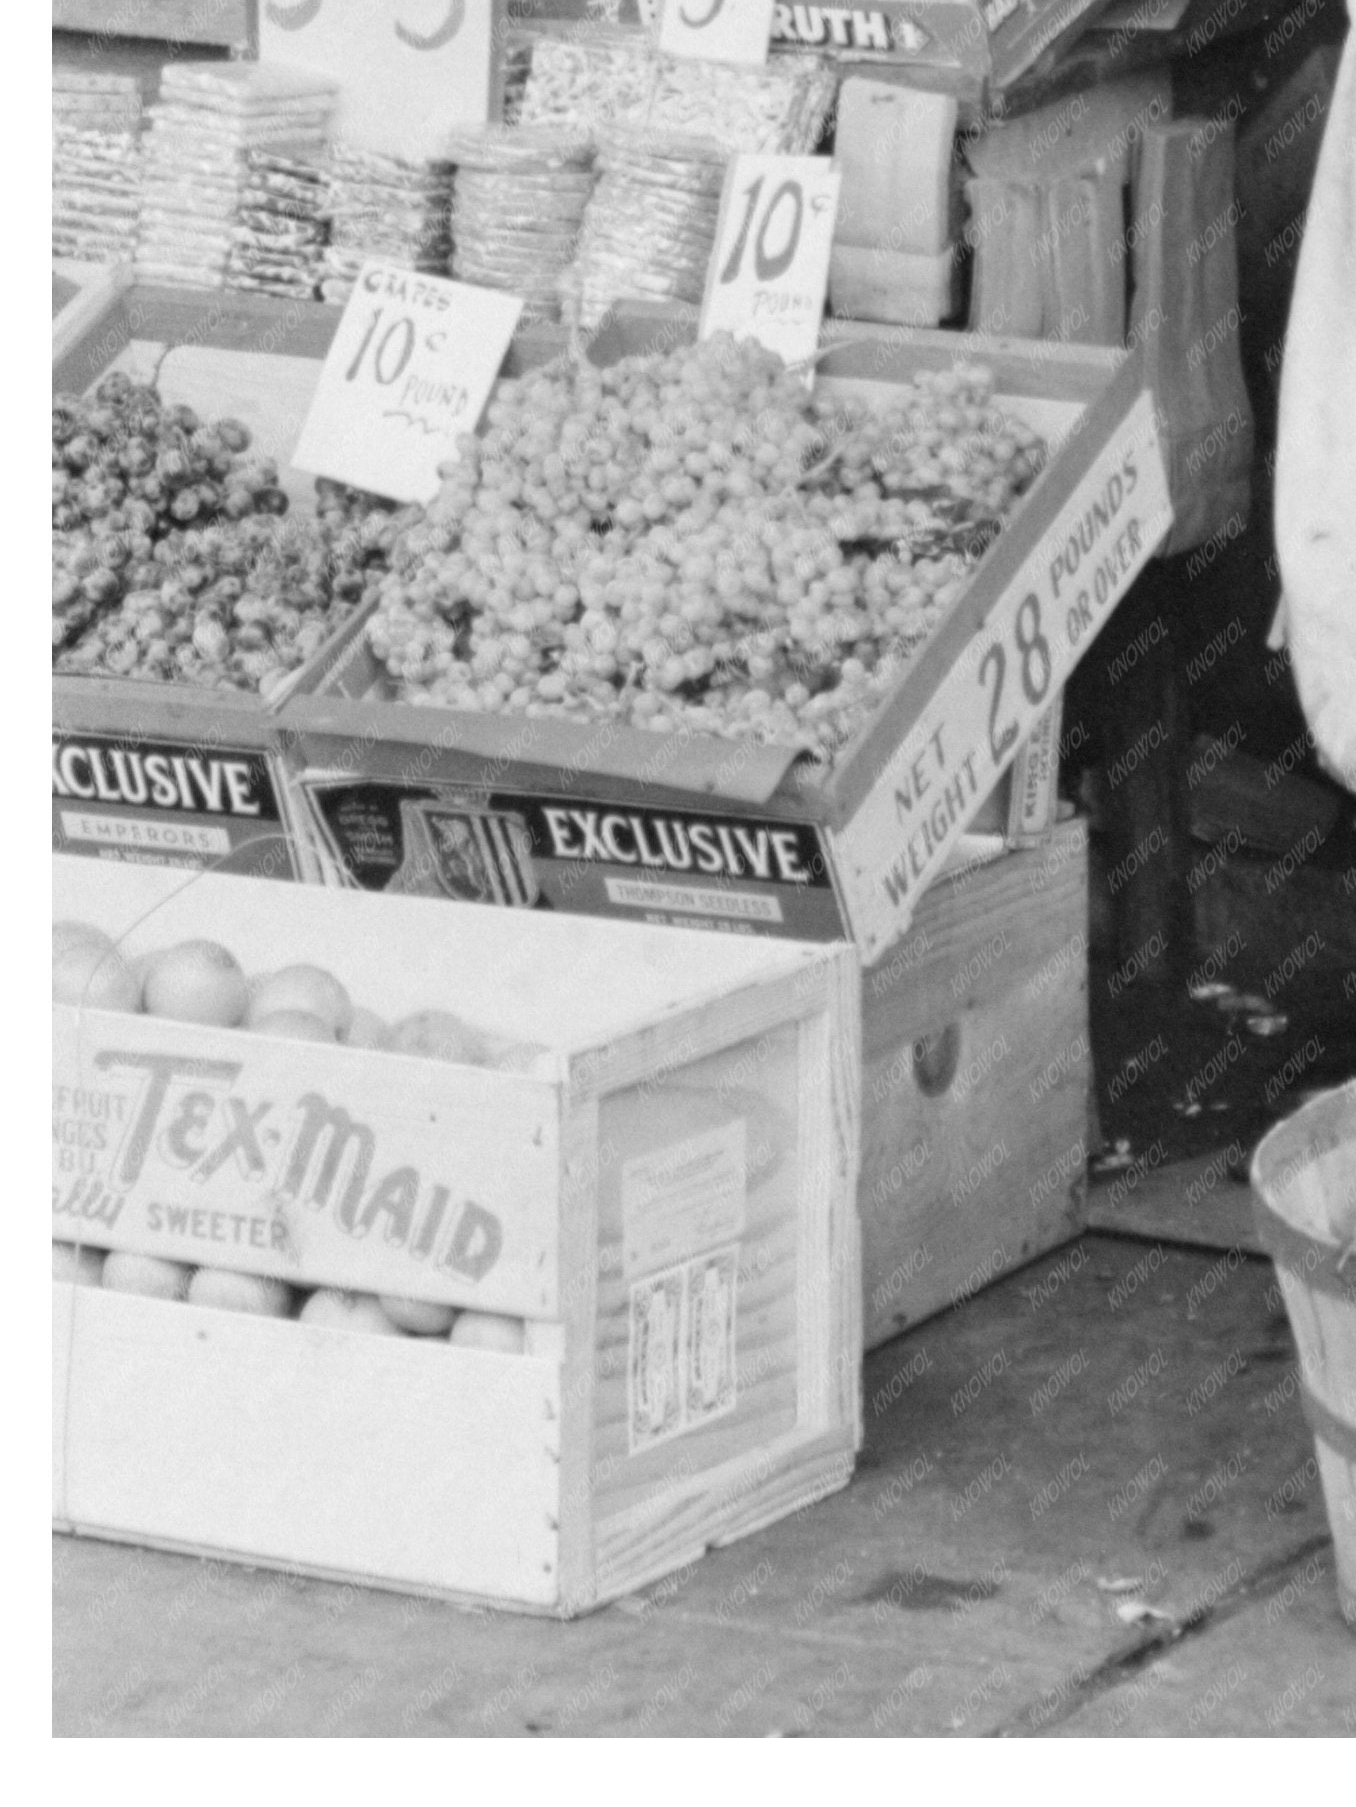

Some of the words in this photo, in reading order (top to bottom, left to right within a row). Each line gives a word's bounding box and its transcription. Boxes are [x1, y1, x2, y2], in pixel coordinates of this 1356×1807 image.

[772, 4, 892, 50] RUTH
[1048, 450, 1139, 598] POUNDS
[1065, 599, 1093, 648] OR
[1094, 514, 1146, 605] OVER
[978, 591, 1052, 768] 28
[896, 721, 947, 826] NET
[79, 820, 212, 850] EMPERORS
[540, 805, 810, 885] EXCLUSIVE
[882, 750, 980, 907] WEIGHT
[616, 883, 697, 911] THOMPSON
[699, 894, 774, 920] SEEDLESS
[145, 1202, 292, 1252] SWEETER
